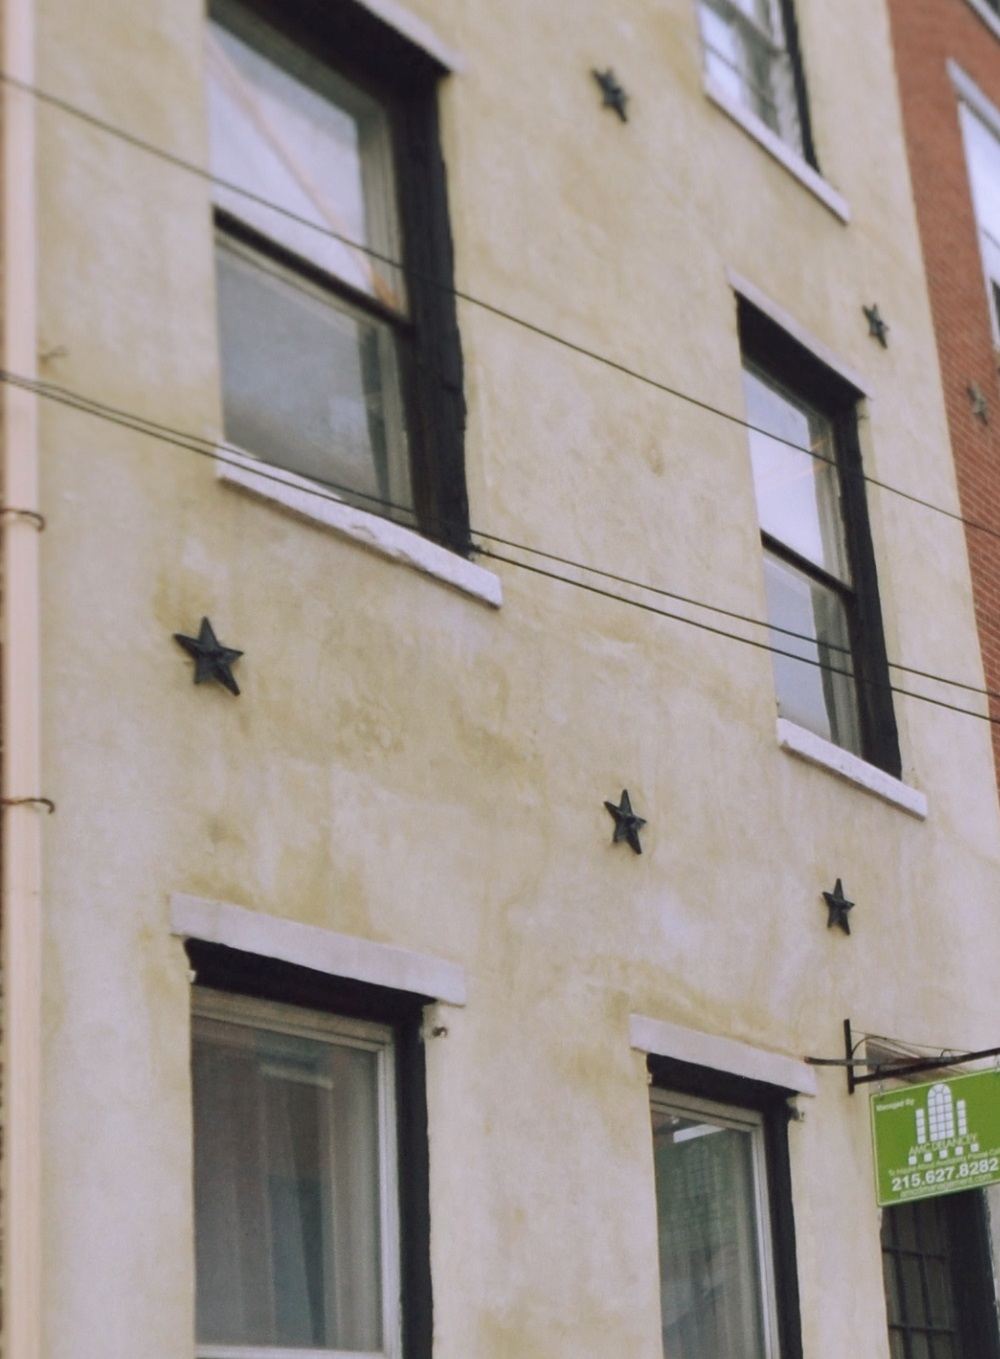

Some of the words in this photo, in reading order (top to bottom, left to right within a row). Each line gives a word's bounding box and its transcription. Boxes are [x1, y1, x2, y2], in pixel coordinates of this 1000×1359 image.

[908, 1144, 930, 1156] AMC
[932, 1134, 978, 1151] DELANCEY
[892, 1157, 999, 1192] 215.627.8282
